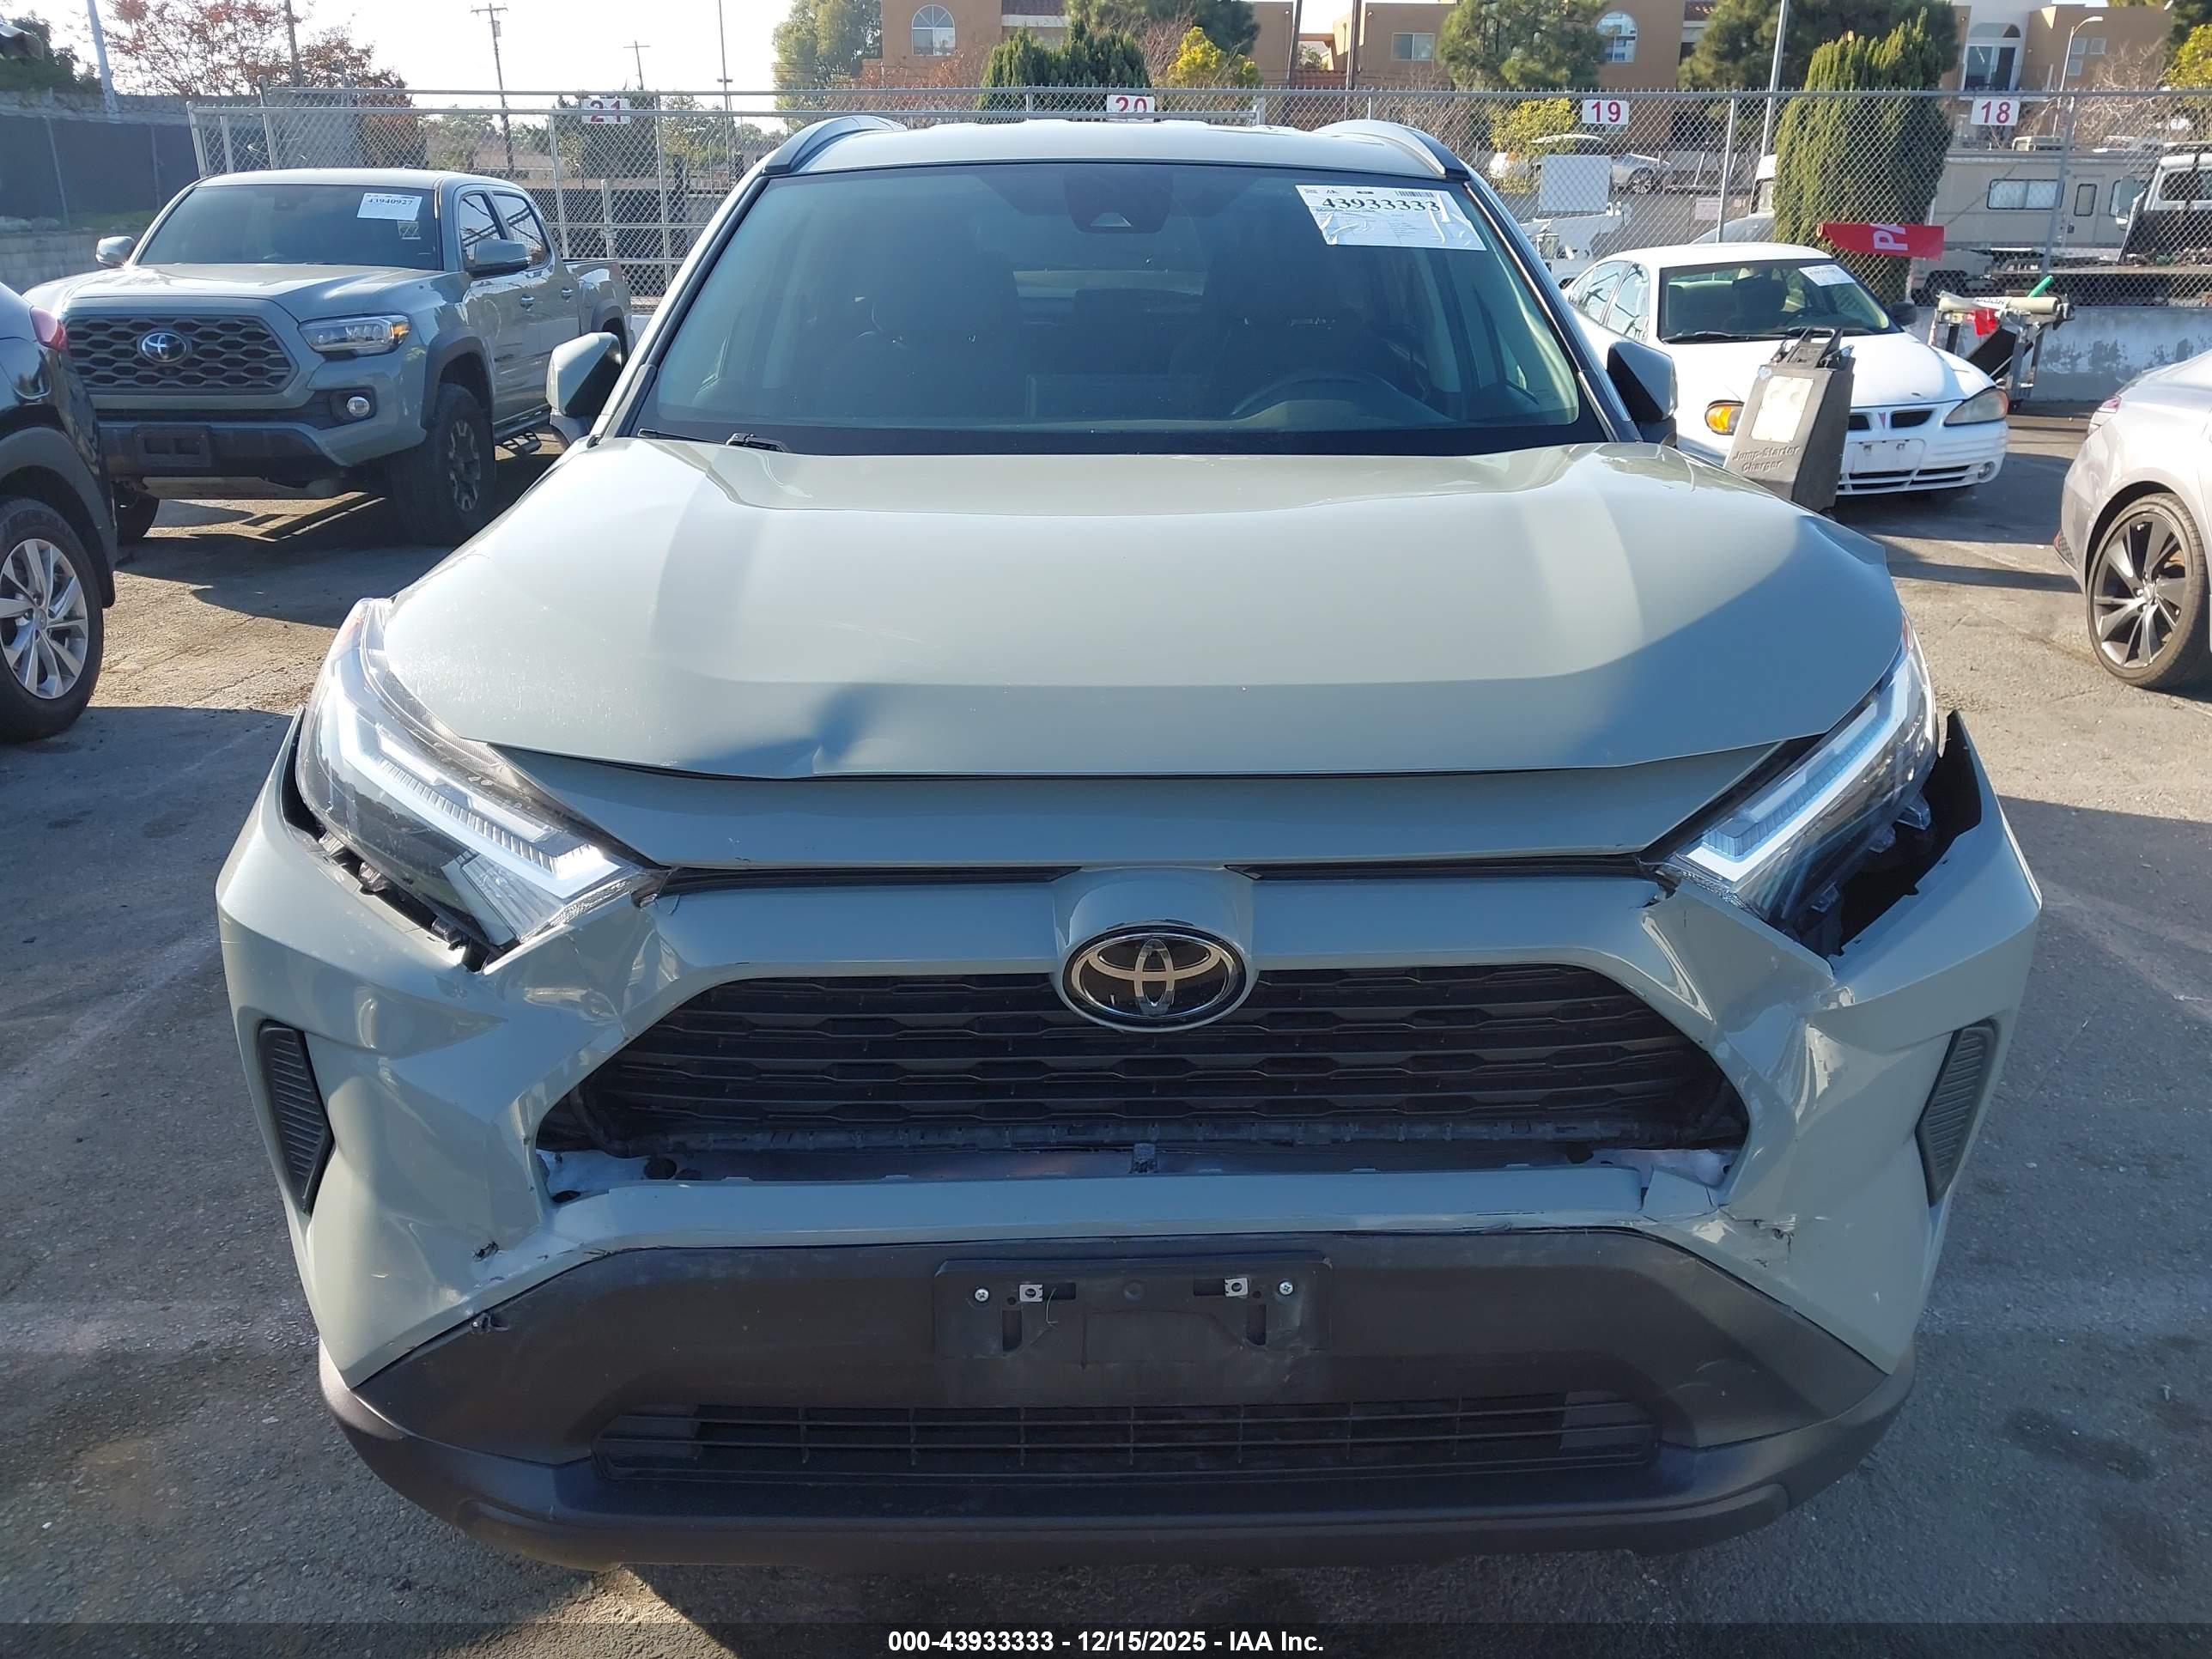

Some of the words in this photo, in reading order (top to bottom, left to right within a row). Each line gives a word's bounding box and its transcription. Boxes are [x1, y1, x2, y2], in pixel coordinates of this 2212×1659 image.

[590, 100, 621, 123] 21
[1115, 96, 1147, 112] 20
[1590, 100, 1622, 124] 19
[1981, 100, 2011, 125] 18
[1322, 198, 1441, 213] 43933333
